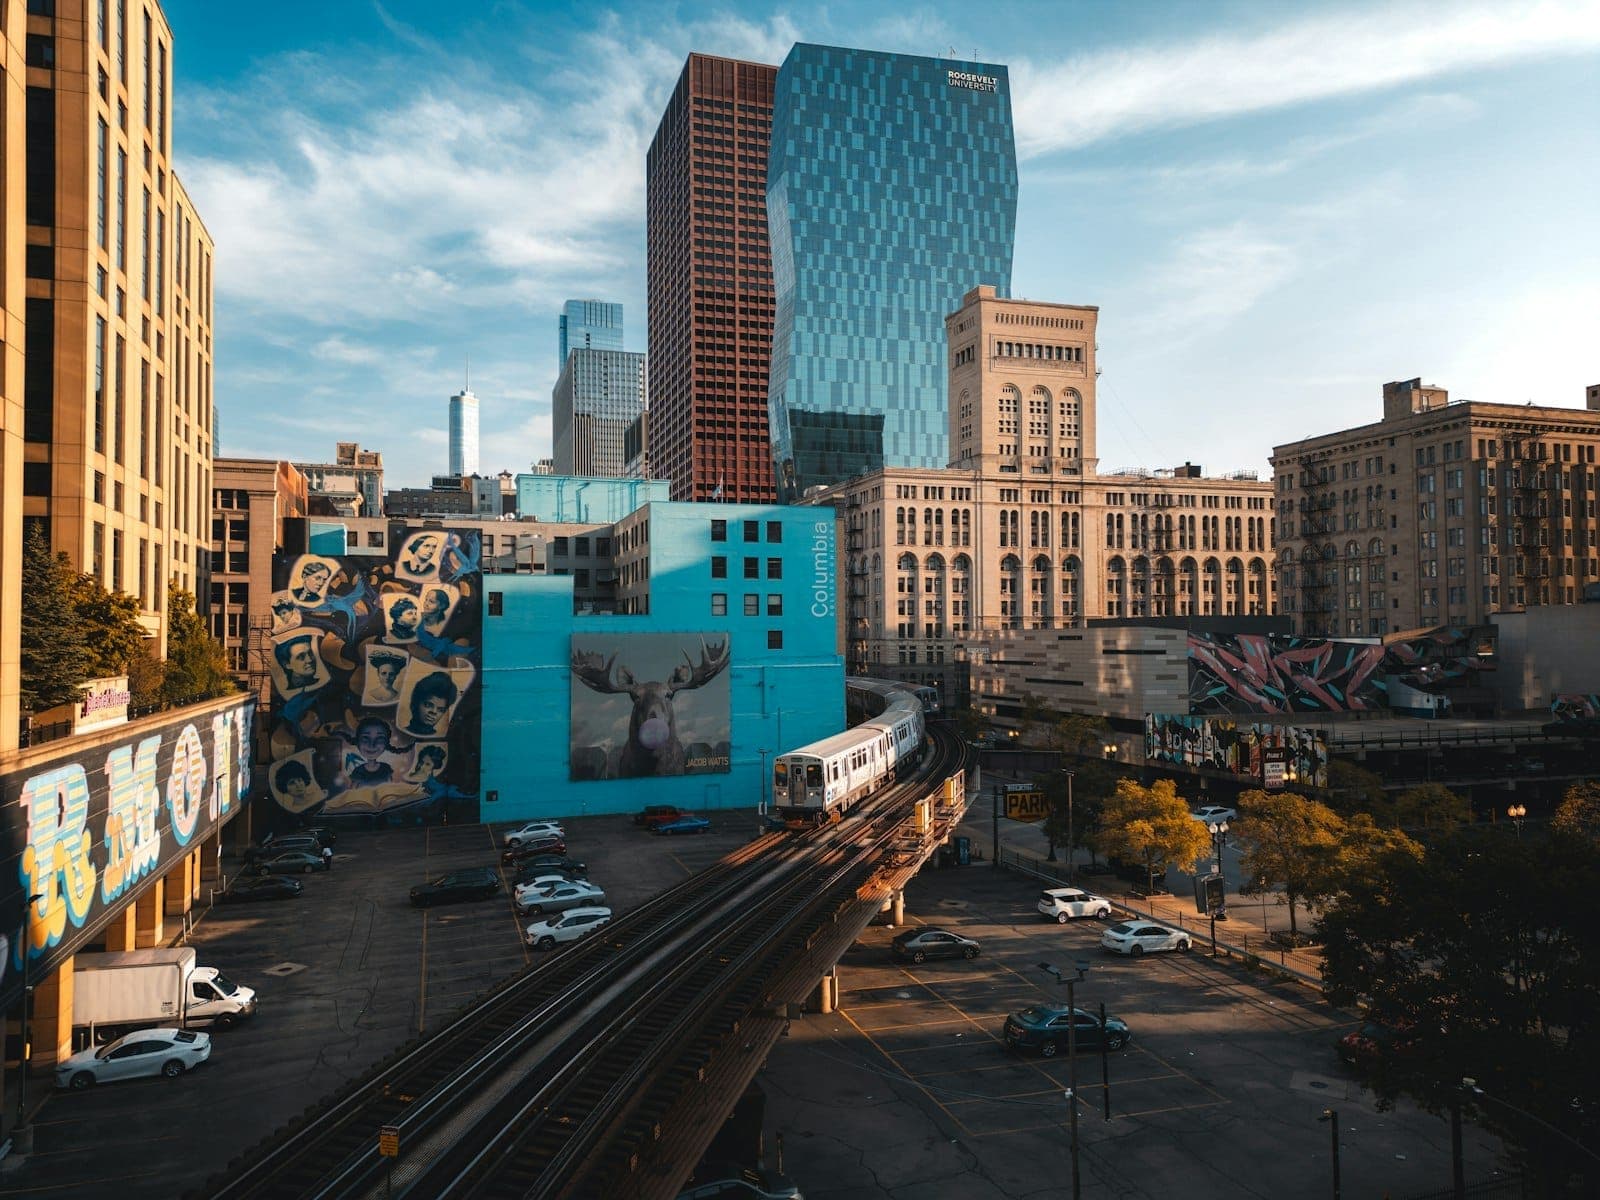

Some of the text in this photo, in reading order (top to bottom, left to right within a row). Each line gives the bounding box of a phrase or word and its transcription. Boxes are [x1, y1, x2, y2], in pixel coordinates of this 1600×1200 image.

[948, 70, 998, 85] ROOSEVELT
[948, 79, 997, 92] UNIVERSITY
[811, 521, 828, 618] Columbia
[686, 756, 729, 768] JACOB WATTS
